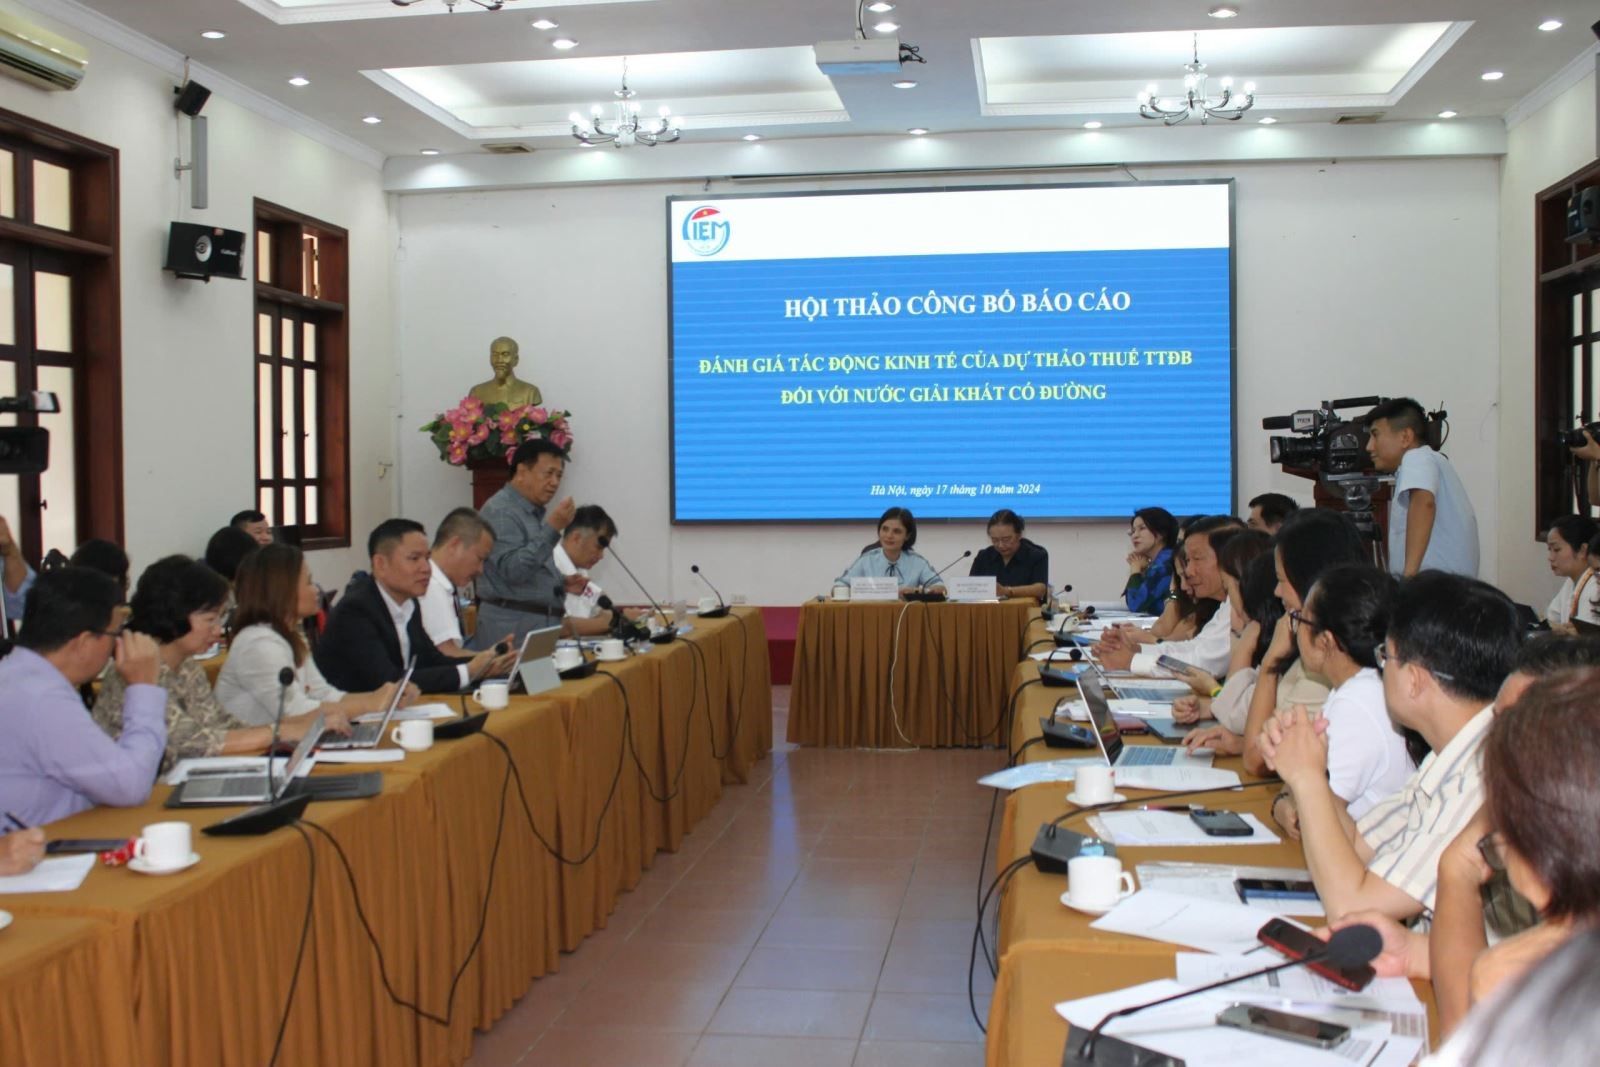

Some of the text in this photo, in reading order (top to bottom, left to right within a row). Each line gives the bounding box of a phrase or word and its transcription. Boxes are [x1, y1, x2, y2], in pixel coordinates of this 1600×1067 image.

[784, 287, 1131, 322] HỘI THẢO CÔNG BỐ BÁO CÁO
[699, 355, 748, 374] ĐÁNH
[752, 354, 785, 373] GIÁ
[789, 353, 824, 372] TÁC
[828, 354, 880, 374] ĐỘNG
[884, 354, 930, 371] KINH
[962, 350, 999, 369] CỦA
[1003, 351, 1030, 371] DỰ
[1034, 349, 1086, 368] THẢO
[1089, 347, 1140, 367] THUẾ
[1143, 350, 1193, 366] TTĐB
[817, 385, 849, 404] VỚI
[854, 384, 905, 403] NƯỚC
[909, 383, 948, 402] GIẢI
[953, 382, 1005, 401] KHÁT
[1009, 381, 1035, 400] CÓ
[1039, 382, 1107, 400] ĐƯỜNG
[870, 484, 1041, 498] Hà Nội, ngày 17 tháng 10 năm 2024
